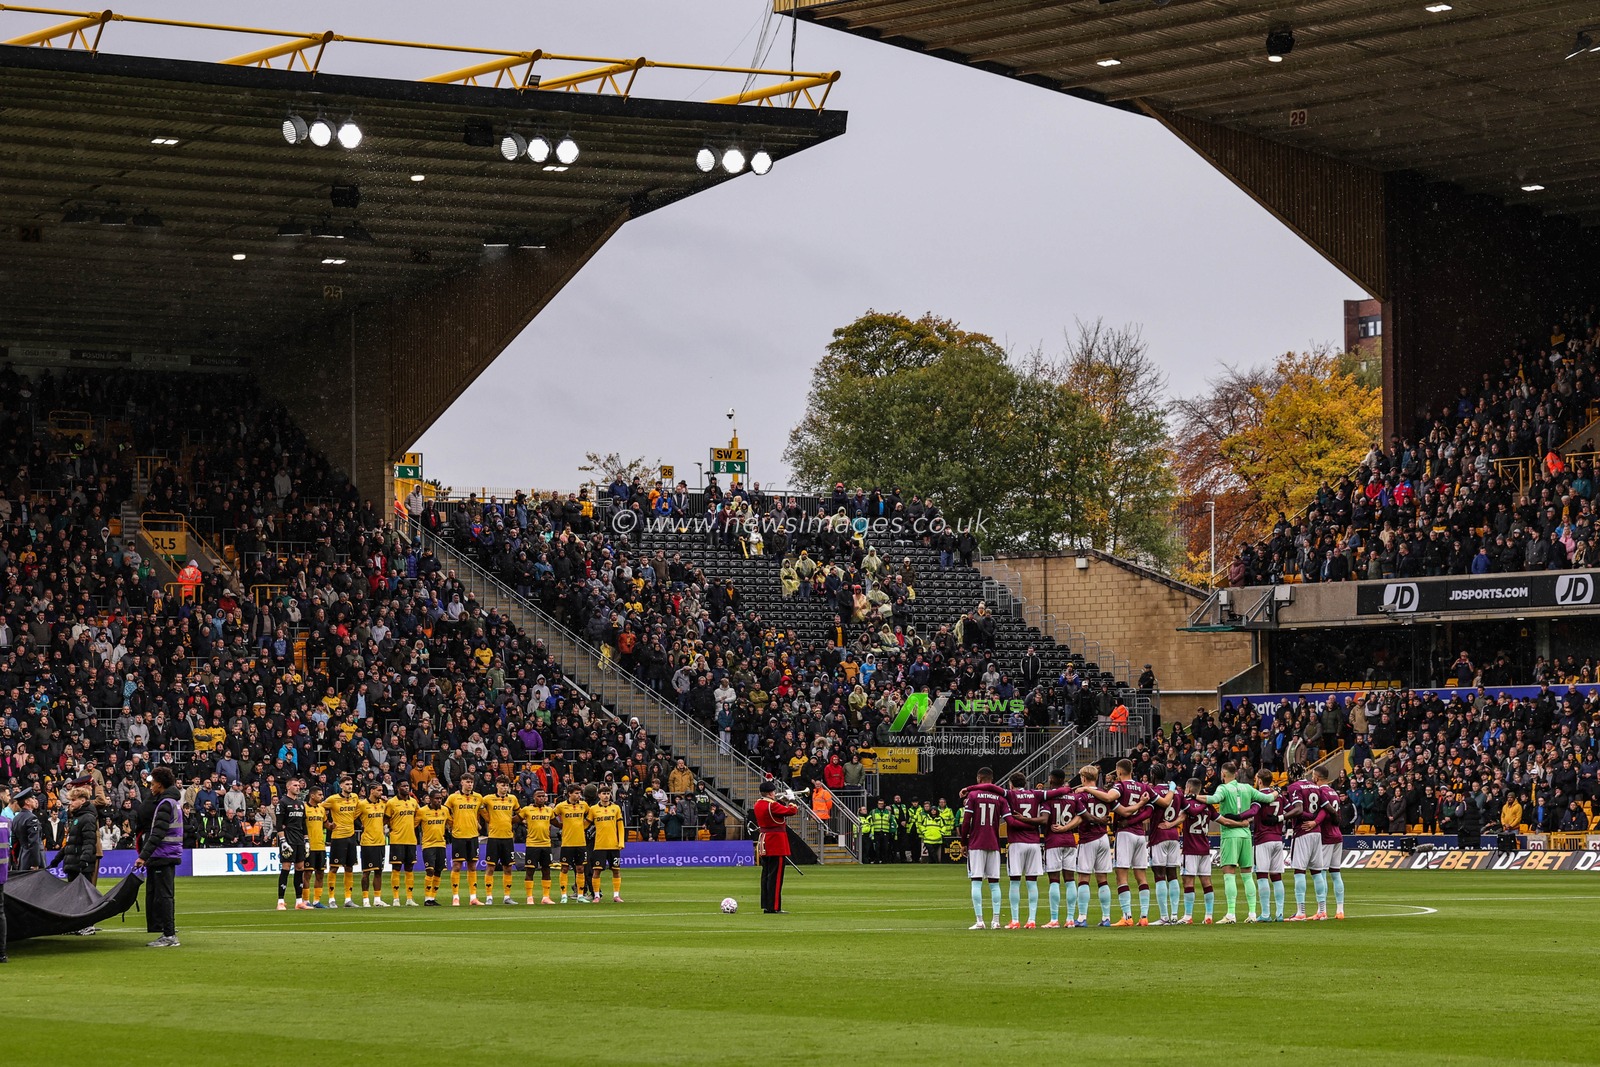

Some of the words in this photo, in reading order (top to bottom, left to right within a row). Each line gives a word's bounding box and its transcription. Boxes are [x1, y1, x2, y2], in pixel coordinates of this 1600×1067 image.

[1291, 111, 1306, 125] 29
[411, 455, 416, 463] 1
[716, 450, 733, 460] SW
[736, 451, 743, 460] 2
[662, 468, 673, 476] 26
[152, 537, 176, 550] SL5
[1449, 586, 1528, 601] JDSPORTS.COM
[1560, 577, 1589, 602] JD
[1001, 735, 1011, 744] 26
[1308, 792, 1319, 814] 8
[979, 803, 996, 826] 11
[1053, 803, 1073, 826] 16
[619, 853, 755, 867] emierleague.com/po
[1340, 850, 1410, 869] DEBET
[1410, 850, 1490, 869] DEBET
[1492, 851, 1573, 870] DEBET
